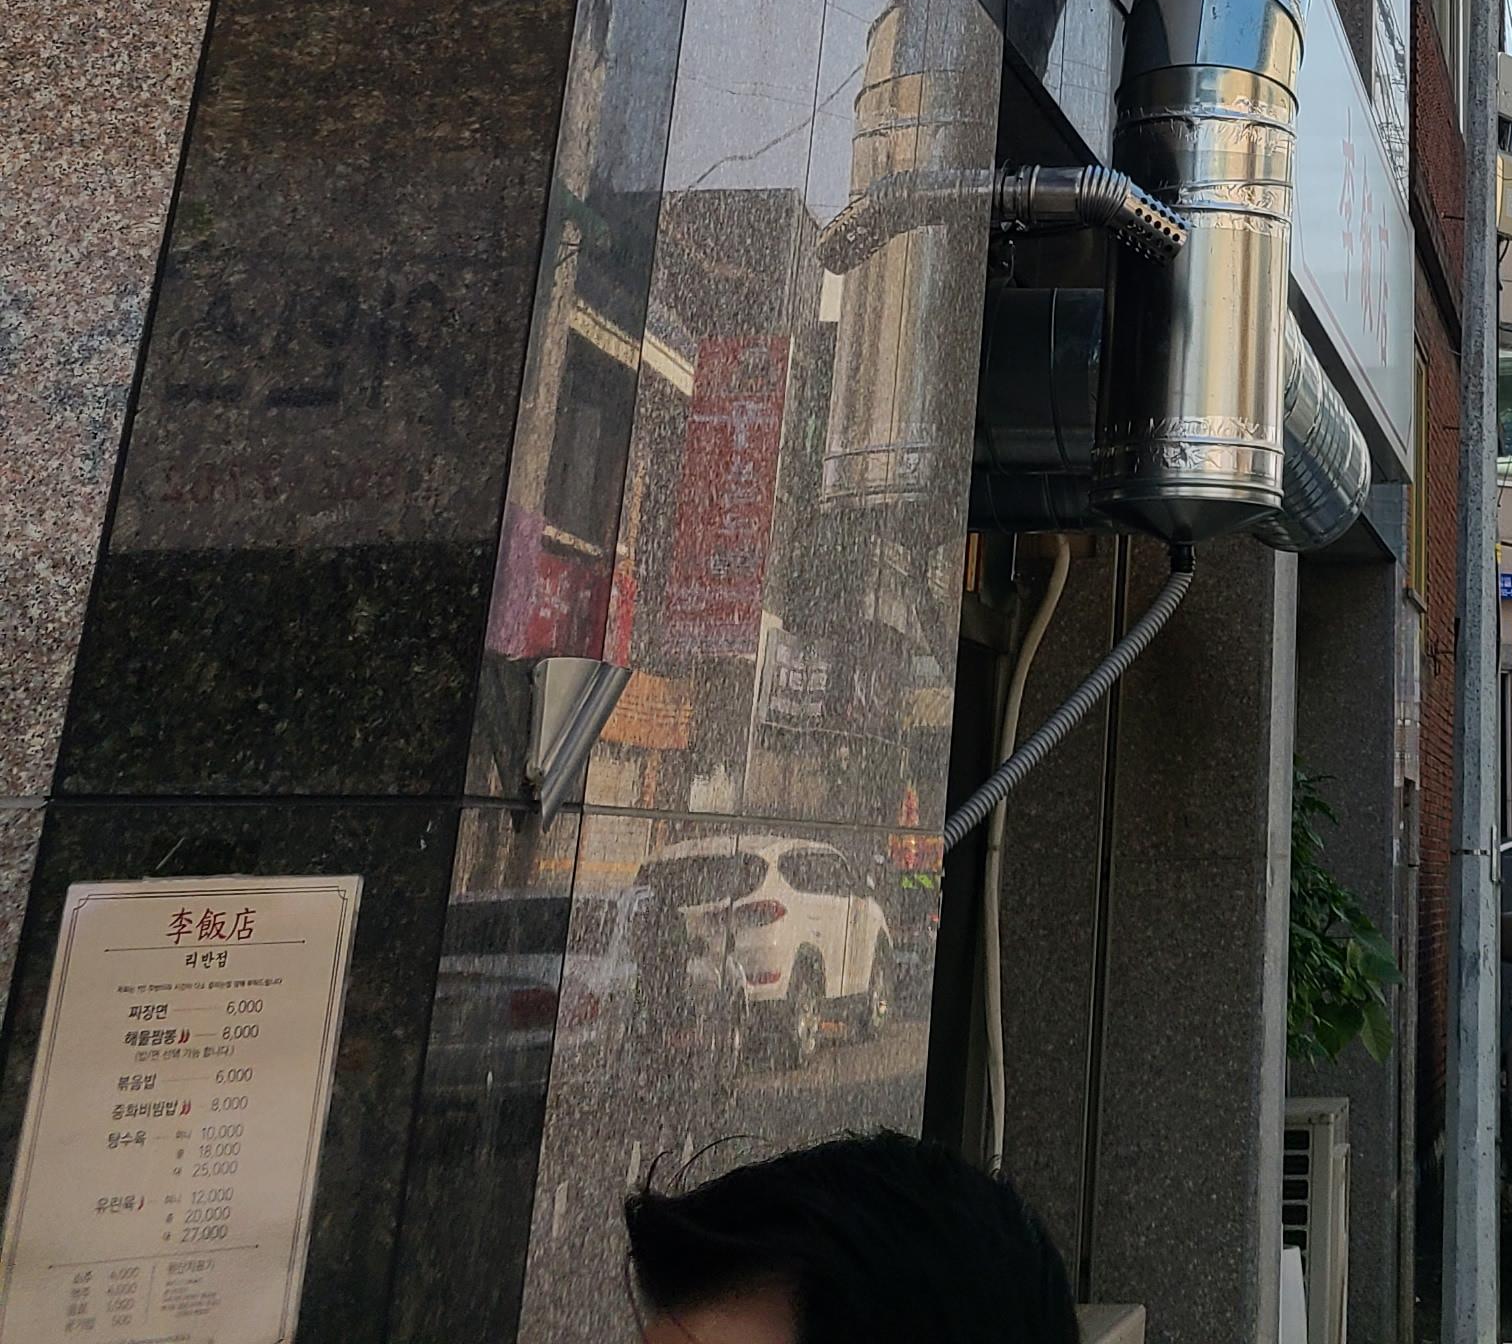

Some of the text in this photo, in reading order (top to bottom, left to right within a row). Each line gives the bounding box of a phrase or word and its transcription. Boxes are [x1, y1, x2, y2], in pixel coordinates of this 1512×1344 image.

[165, 907, 256, 945] 李飯店
[185, 950, 229, 969] 리반점
[226, 999, 264, 1016] 6,000
[124, 1024, 260, 1047] 해물짬뽕 8,000
[118, 1068, 254, 1091] 볶음밥 6,000
[112, 1095, 249, 1121] 중화비빔밥 8,000
[108, 1130, 147, 1149] 탕수육
[201, 1124, 244, 1141] 10,000
[200, 1142, 241, 1158] 18,000
[192, 1161, 238, 1178] 25,000
[191, 1187, 234, 1204] 12,000
[184, 1206, 231, 1224] 20,000
[181, 1224, 229, 1243] 27,000
